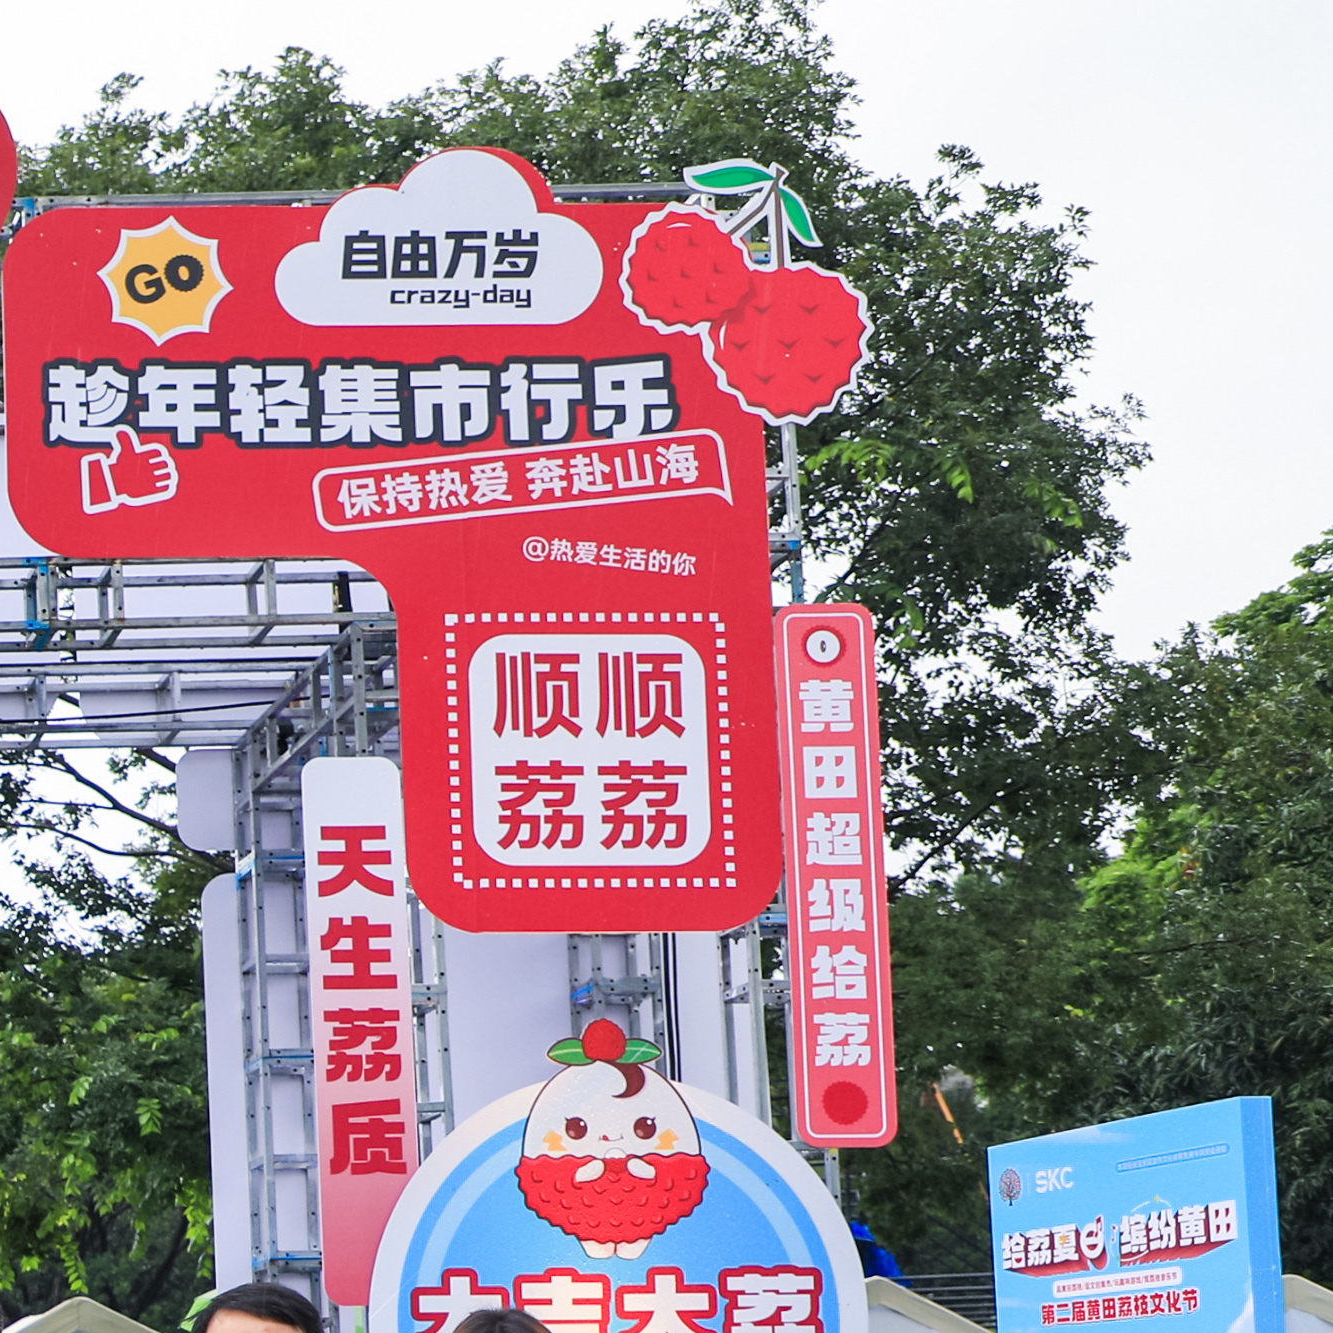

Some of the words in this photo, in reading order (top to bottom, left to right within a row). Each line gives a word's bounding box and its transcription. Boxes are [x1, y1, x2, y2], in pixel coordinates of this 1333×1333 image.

[125, 253, 205, 306] GO
[341, 229, 541, 281] 自由万岁
[389, 284, 532, 310] crazy-day
[46, 358, 676, 445] 趁年轻集市行乐
[337, 460, 513, 520] 保持热爱
[525, 442, 700, 501] 奔赴山海
[521, 535, 697, 578] @热爱生活的你
[492, 651, 686, 739] 顺顺
[493, 760, 689, 850] 荔荔
[798, 678, 872, 1068] 黄田超级给荔
[317, 825, 408, 1175] 天生荔质
[1035, 1167, 1074, 1194] SKC
[1119, 1200, 1238, 1256] 缤纷黄田
[1041, 1289, 1198, 1326] 第二届黄田荔枝文化节
